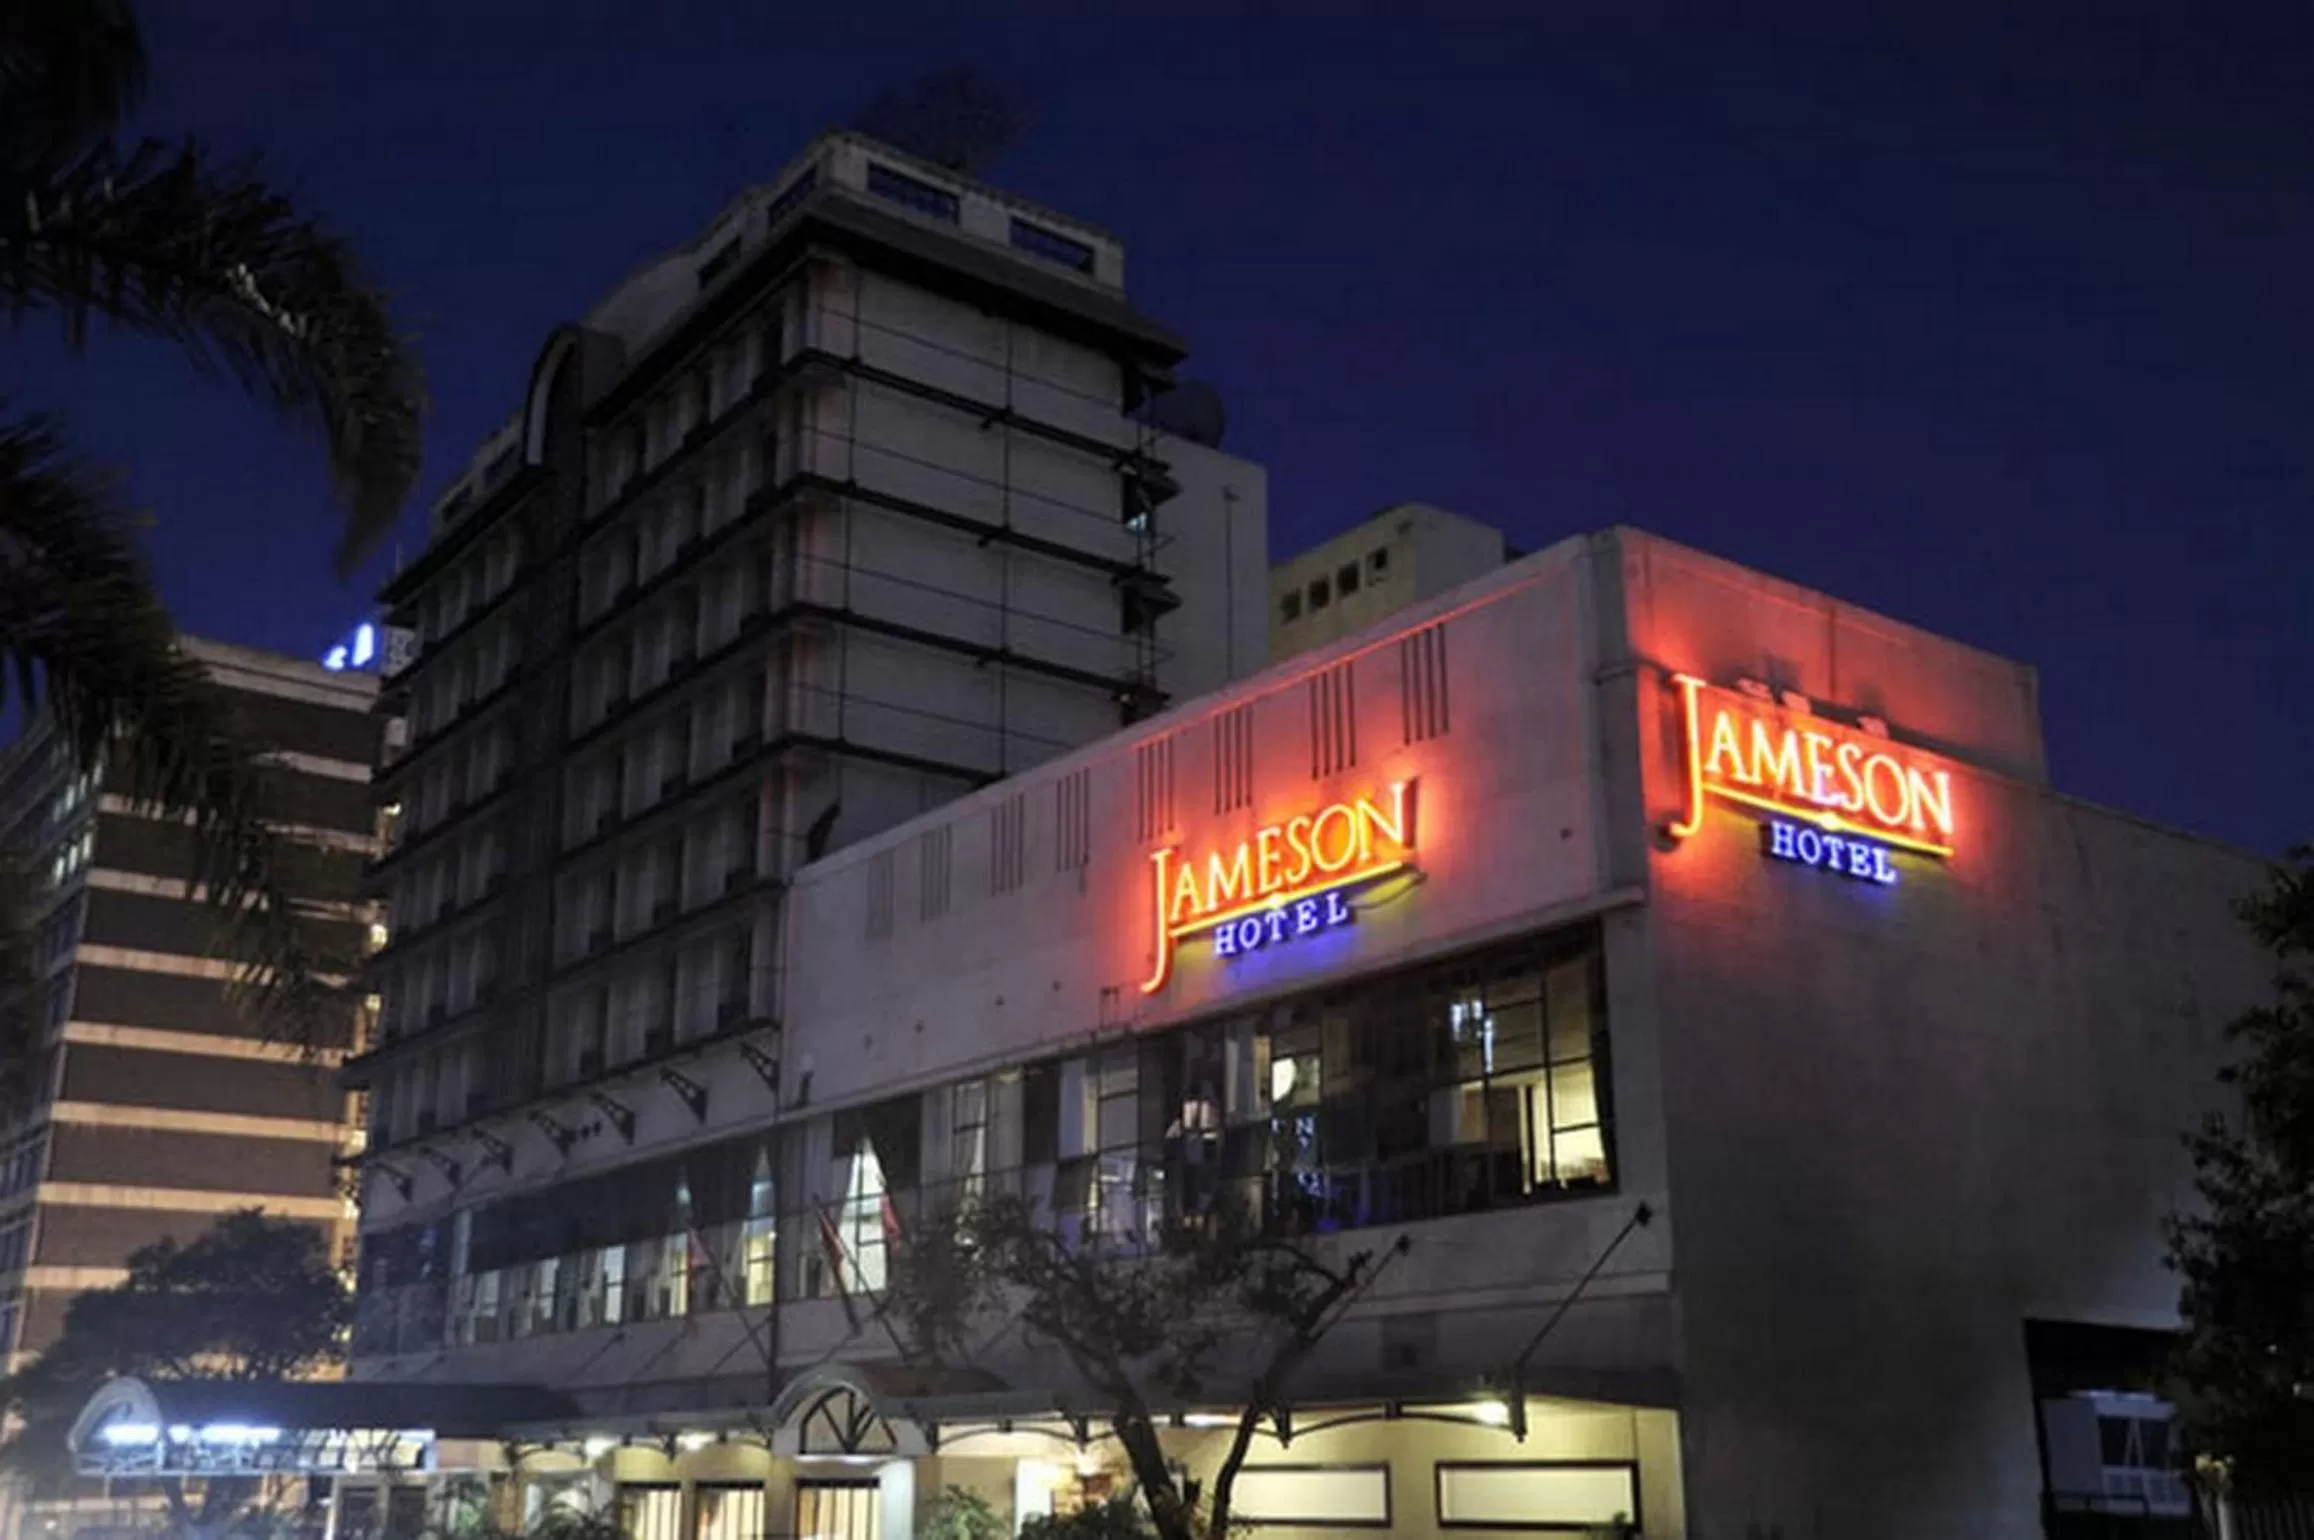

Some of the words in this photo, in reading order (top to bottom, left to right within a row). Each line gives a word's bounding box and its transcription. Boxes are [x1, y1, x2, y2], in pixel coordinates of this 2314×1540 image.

[1669, 673, 1954, 837] JAMESON
[1140, 780, 1405, 993] JAMESON
[1770, 820, 1897, 884] HOTEL
[1213, 891, 1349, 956] HOTEL
